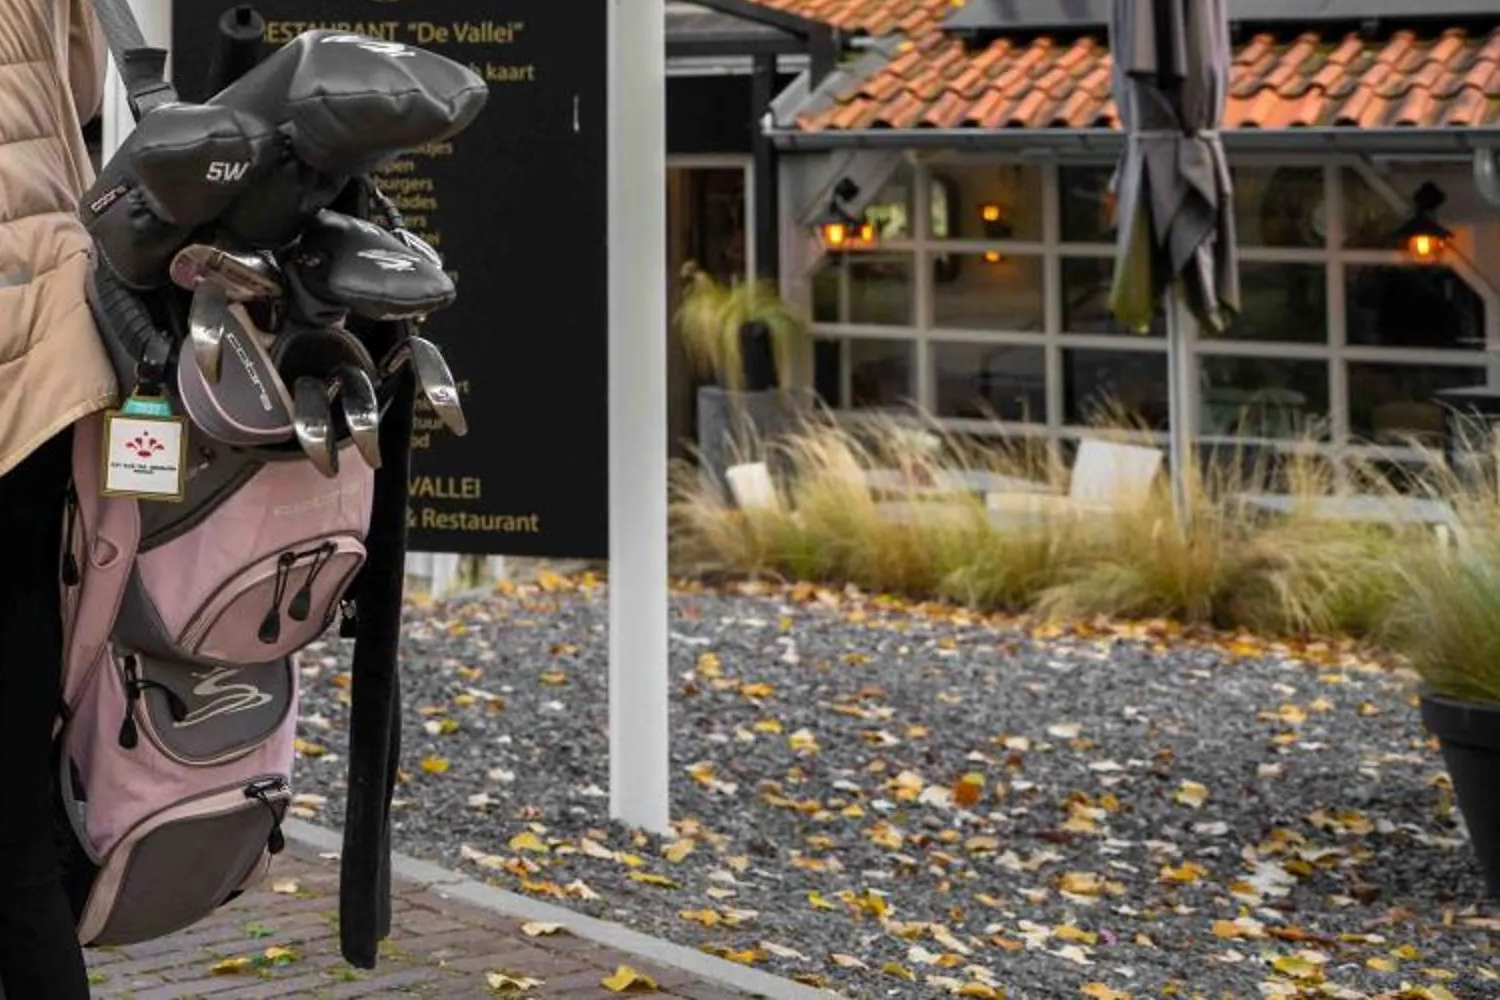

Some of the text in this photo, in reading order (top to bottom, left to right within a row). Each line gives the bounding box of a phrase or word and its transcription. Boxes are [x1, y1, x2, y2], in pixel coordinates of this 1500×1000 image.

[485, 62, 535, 81] kaart
[206, 161, 250, 181] 5W
[407, 475, 482, 499] VALLEI
[421, 507, 540, 533] Restaurant
